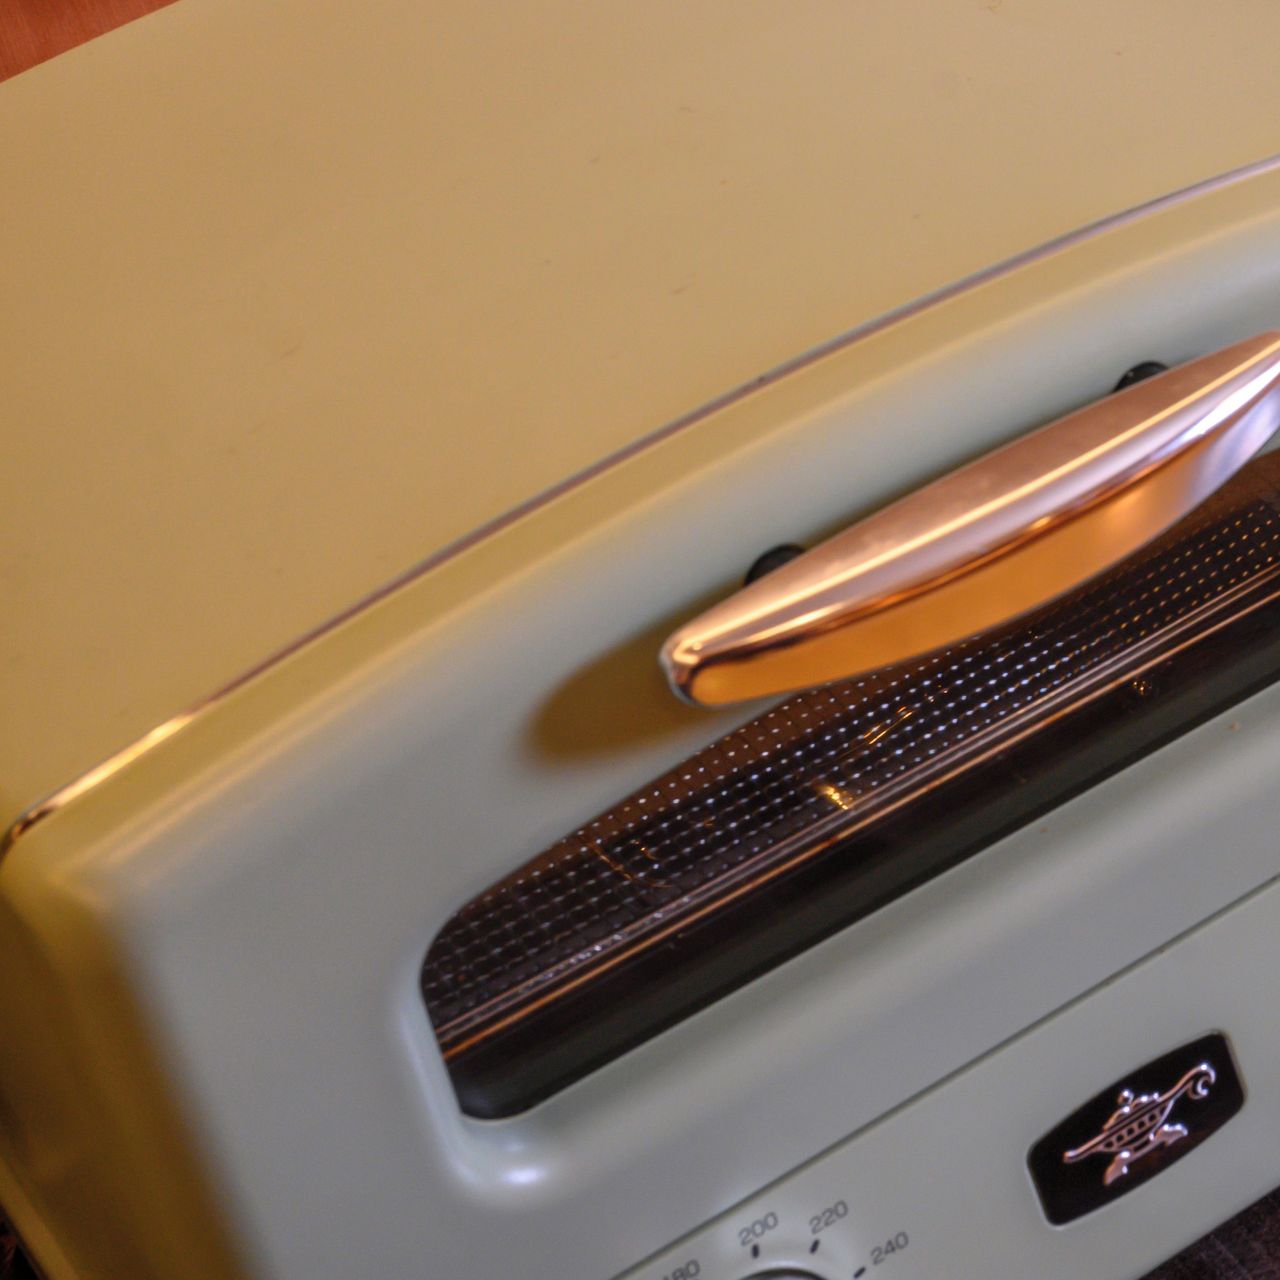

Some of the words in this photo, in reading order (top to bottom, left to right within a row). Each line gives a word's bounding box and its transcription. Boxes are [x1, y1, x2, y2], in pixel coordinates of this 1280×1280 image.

[738, 1211, 779, 1247] 200
[809, 1200, 849, 1235] 220
[870, 1231, 910, 1266] 240
